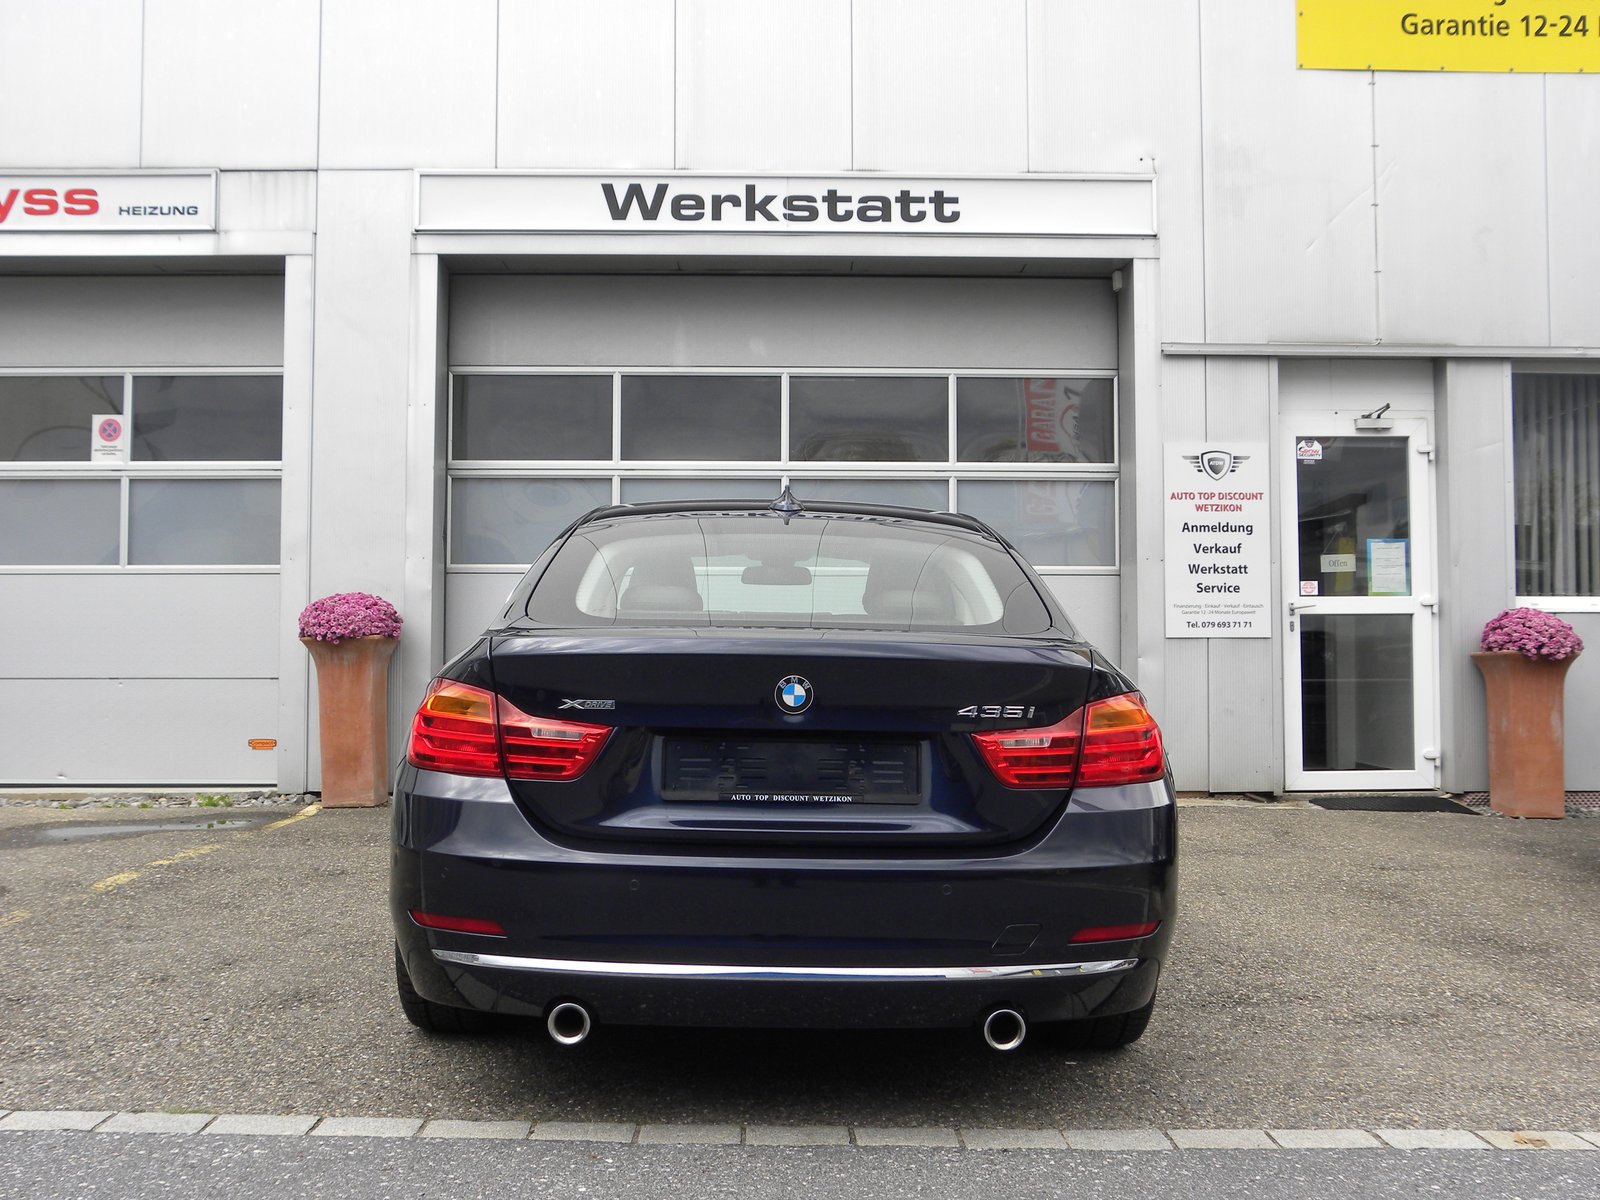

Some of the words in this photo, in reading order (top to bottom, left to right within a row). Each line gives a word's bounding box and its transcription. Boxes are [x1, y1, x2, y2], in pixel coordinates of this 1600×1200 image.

[1400, 12, 1510, 37] Garantie
[1520, 14, 1589, 37] 12-24
[600, 183, 961, 223] Werkstatt
[118, 205, 199, 216] HEIZUNG
[1170, 491, 1195, 501] AUTO
[1197, 491, 1216, 501] TOP
[1218, 492, 1264, 501] DISCOUNT
[1194, 503, 1243, 513] WETZIKON
[1181, 521, 1254, 536] Anmeldung
[1192, 542, 1242, 554] Verkauf
[1187, 563, 1249, 575] Werkstatt
[1328, 559, 1348, 568] Offen
[1196, 582, 1241, 594] Service
[1186, 621, 1201, 629] Tel.
[1201, 621, 1216, 629] 079
[1216, 621, 1231, 629] 693
[1232, 621, 1241, 629] 71
[1243, 621, 1252, 629] 71
[779, 677, 811, 690] BMW
[957, 705, 1036, 719] 435i
[812, 795, 853, 803] WETZIKON
